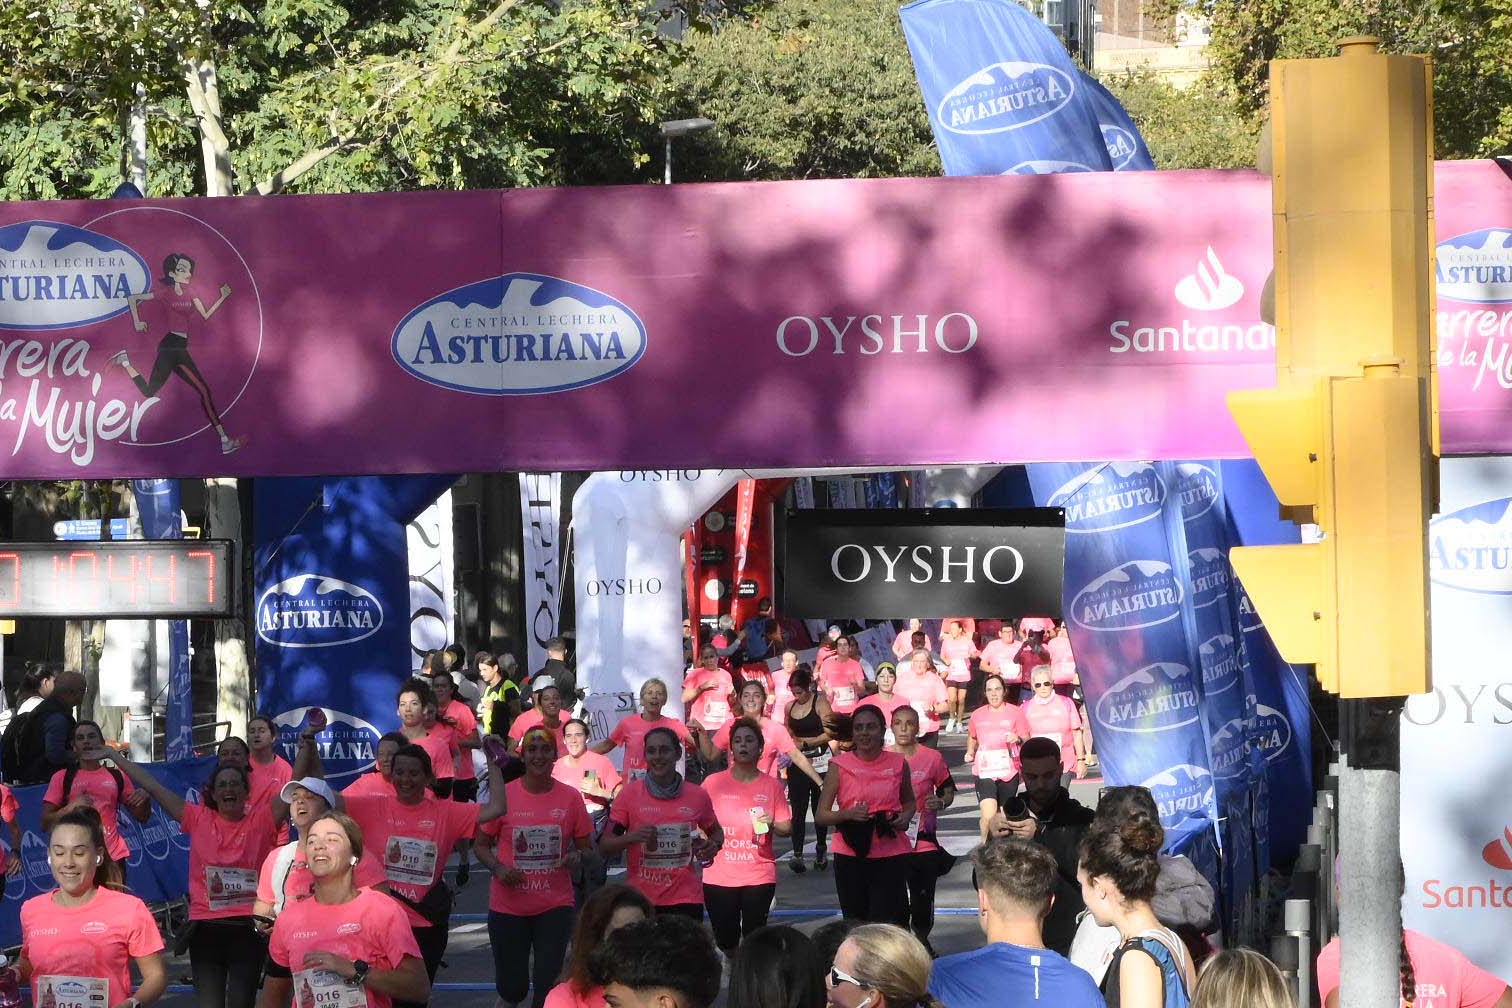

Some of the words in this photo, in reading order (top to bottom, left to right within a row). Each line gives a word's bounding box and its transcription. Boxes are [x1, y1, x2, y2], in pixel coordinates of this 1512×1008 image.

[55, 256, 126, 269] LECHERA
[450, 315, 531, 330] CENTRAL
[539, 312, 620, 326] LECHERA
[776, 312, 980, 357] OYSHO
[1438, 309, 1512, 338] arrer
[411, 319, 627, 366] ASTURIANA
[1110, 319, 1277, 353] Santand
[12, 373, 160, 467] Mujer
[831, 544, 1024, 584] OYSHO
[586, 577, 662, 598] OYSHO
[261, 604, 374, 631] ASTURIANA
[274, 600, 316, 609] CENTRAL
[320, 599, 369, 608] LECHERA
[1403, 683, 1512, 725] OYS
[725, 851, 754, 861] SUMA
[316, 990, 340, 1002] 016
